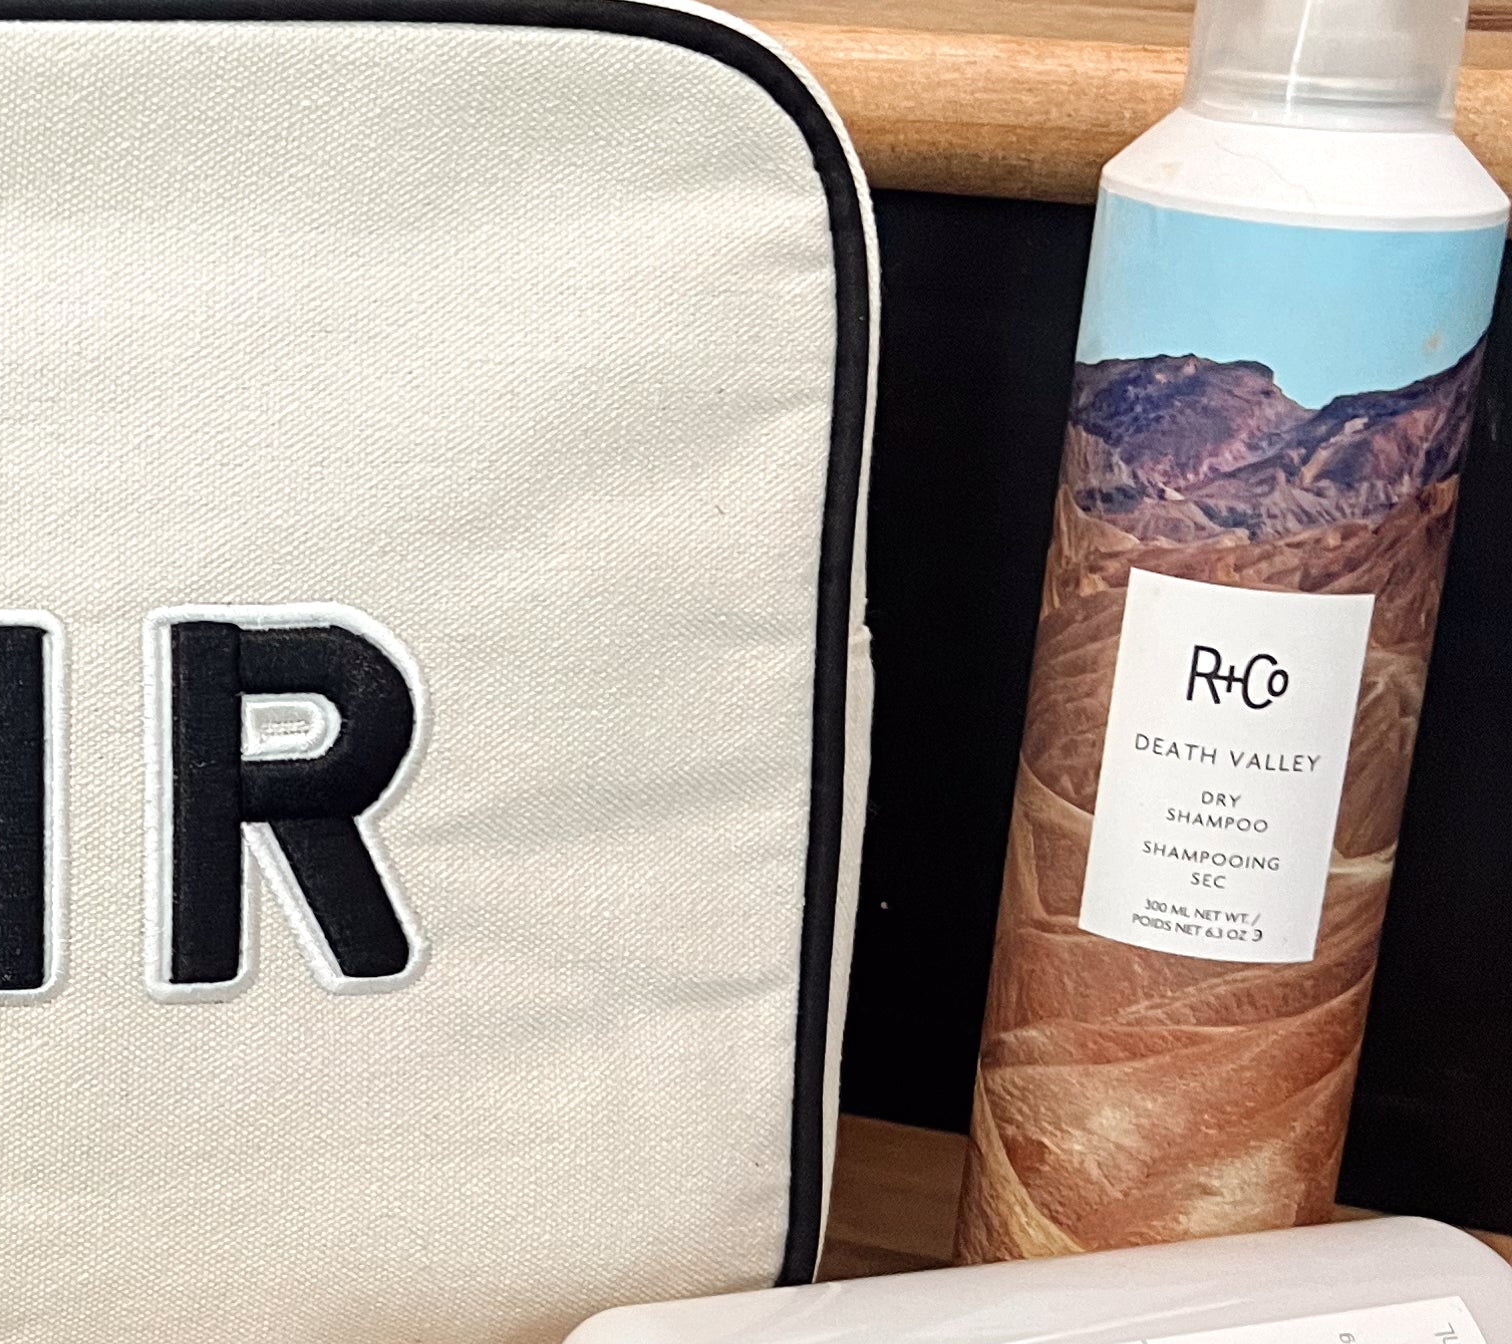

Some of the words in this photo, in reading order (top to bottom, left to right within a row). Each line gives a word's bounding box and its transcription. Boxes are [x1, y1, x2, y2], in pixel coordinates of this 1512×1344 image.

[1185, 644, 1290, 710] R+Co
[1134, 732, 1217, 766] DEATH
[1229, 750, 1322, 773] VALLEY
[1200, 790, 1242, 809] DRY
[1165, 807, 1269, 834] SHAMPOO
[1141, 839, 1281, 872] SHAMPOOING
[1190, 871, 1227, 890] SEC
[1144, 897, 1168, 913] 300
[1171, 904, 1190, 918] ML
[1194, 907, 1222, 921] NET
[1132, 912, 1172, 931] POIDS
[1175, 921, 1203, 936] NET
[1226, 928, 1247, 942] OZ
